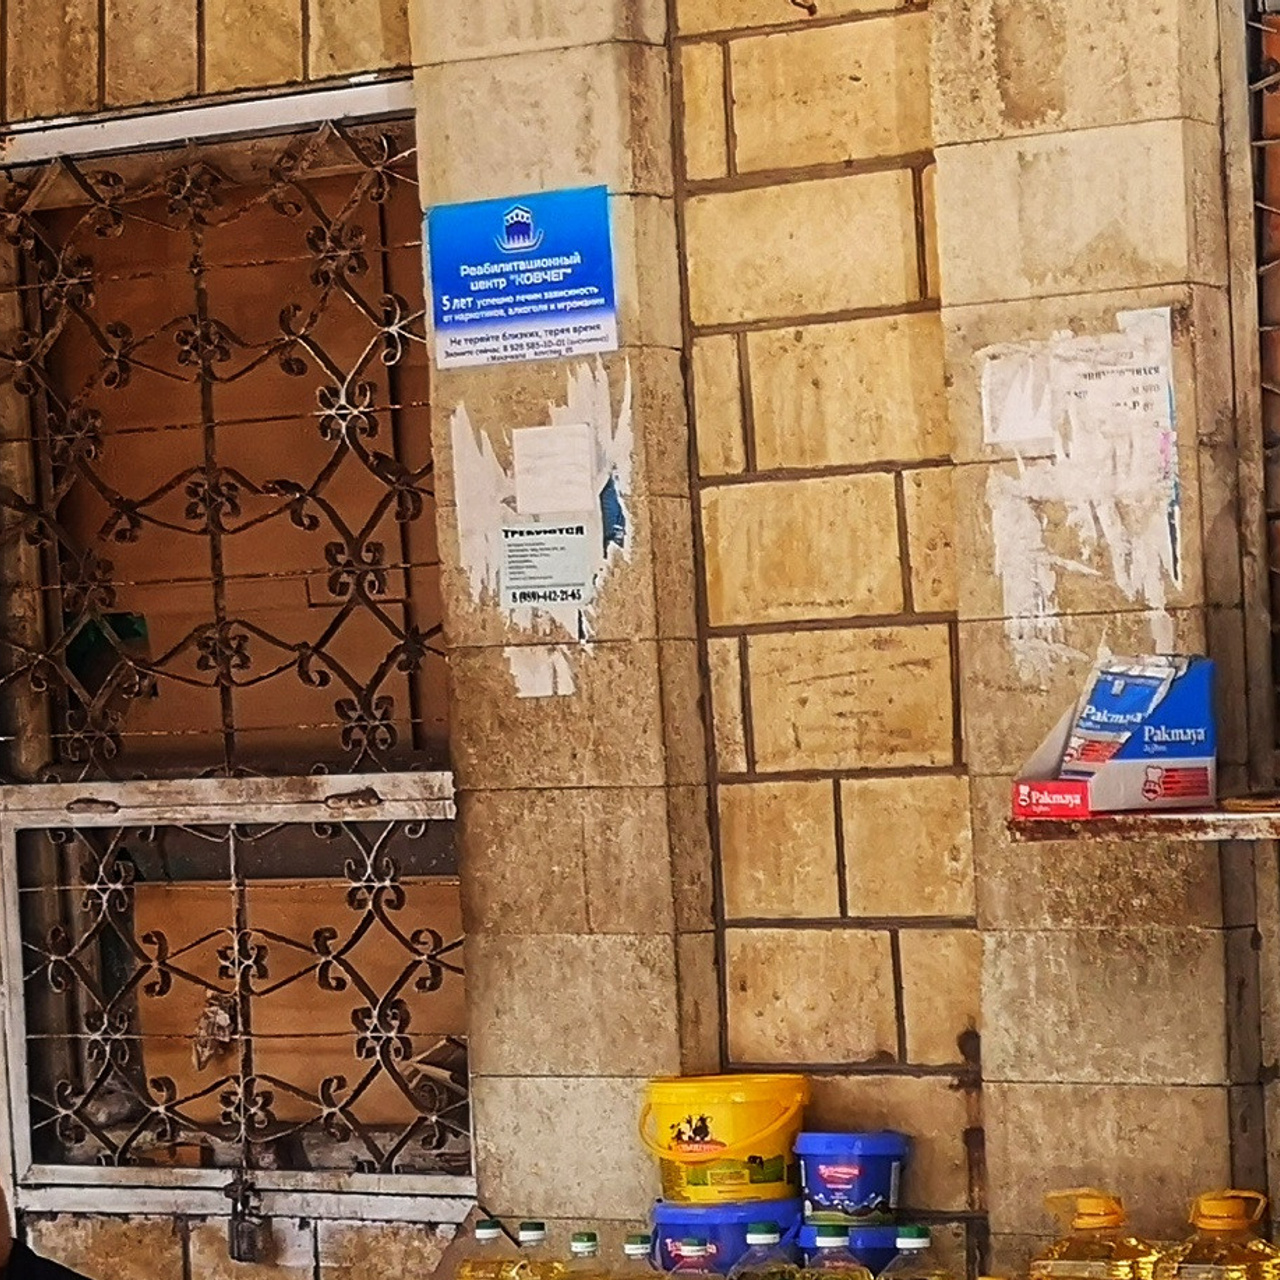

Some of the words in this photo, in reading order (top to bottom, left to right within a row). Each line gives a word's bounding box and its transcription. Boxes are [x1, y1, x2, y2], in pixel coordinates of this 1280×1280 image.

[460, 252, 581, 277] Реабилитационный
[470, 276, 507, 291] центр
[441, 295, 450, 311] 5
[452, 297, 474, 311] лет
[450, 337, 462, 347] Не
[572, 323, 601, 335] время
[502, 525, 584, 539] ТРЕБУЮТСЯ
[1144, 725, 1206, 745] Pakmaya
[1030, 790, 1081, 808] Pakmaya
